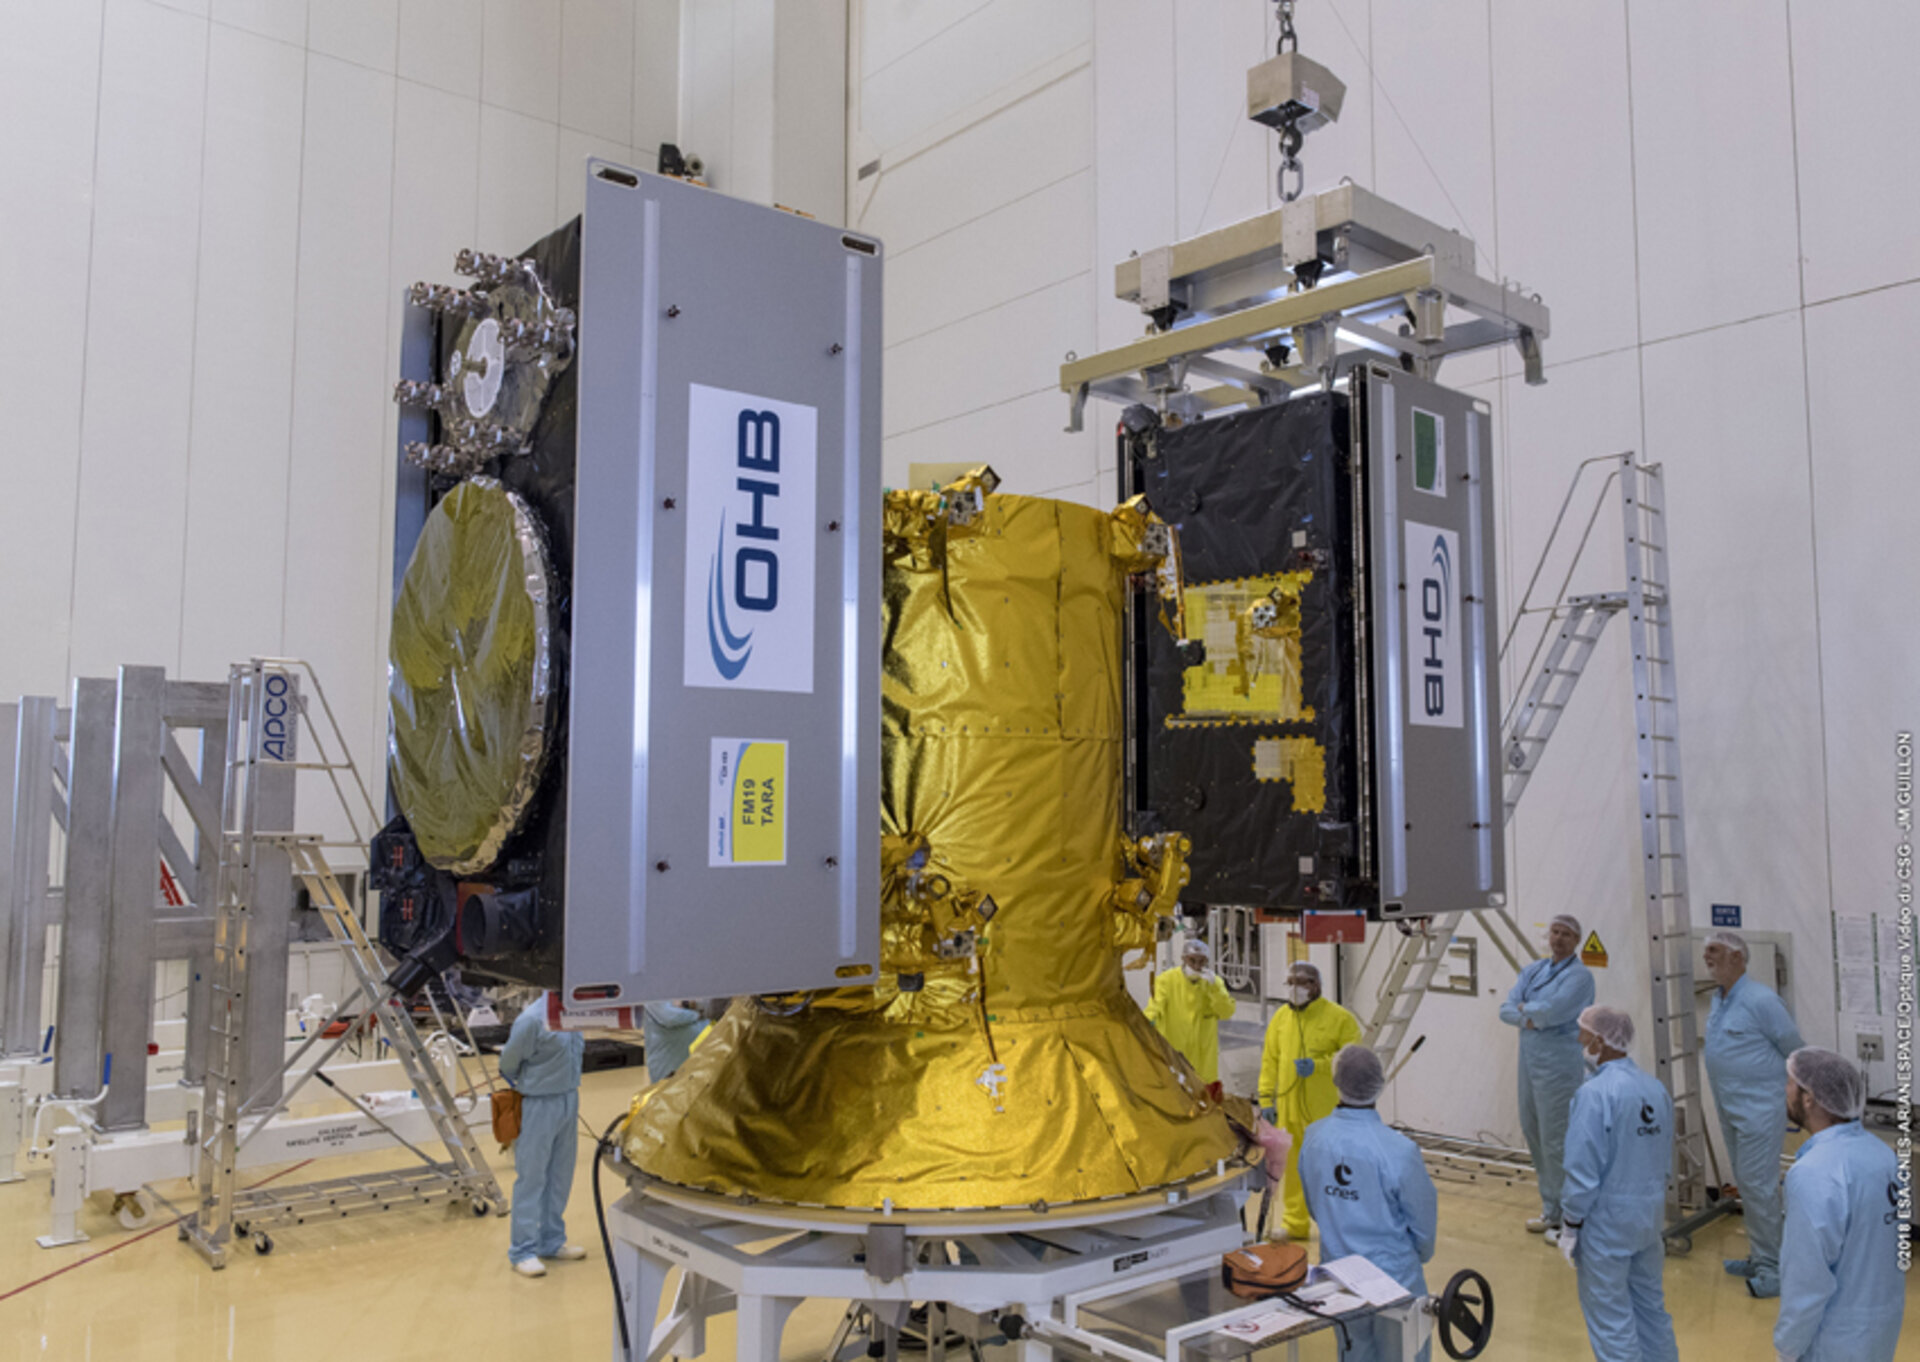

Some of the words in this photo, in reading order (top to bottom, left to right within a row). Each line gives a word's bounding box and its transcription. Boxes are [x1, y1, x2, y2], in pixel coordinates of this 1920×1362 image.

[735, 409, 780, 612] OHB
[1423, 578, 1444, 717] OHB
[742, 778, 756, 825] FM19
[761, 777, 775, 827] TARA
[1324, 1184, 1360, 1202] cnes
